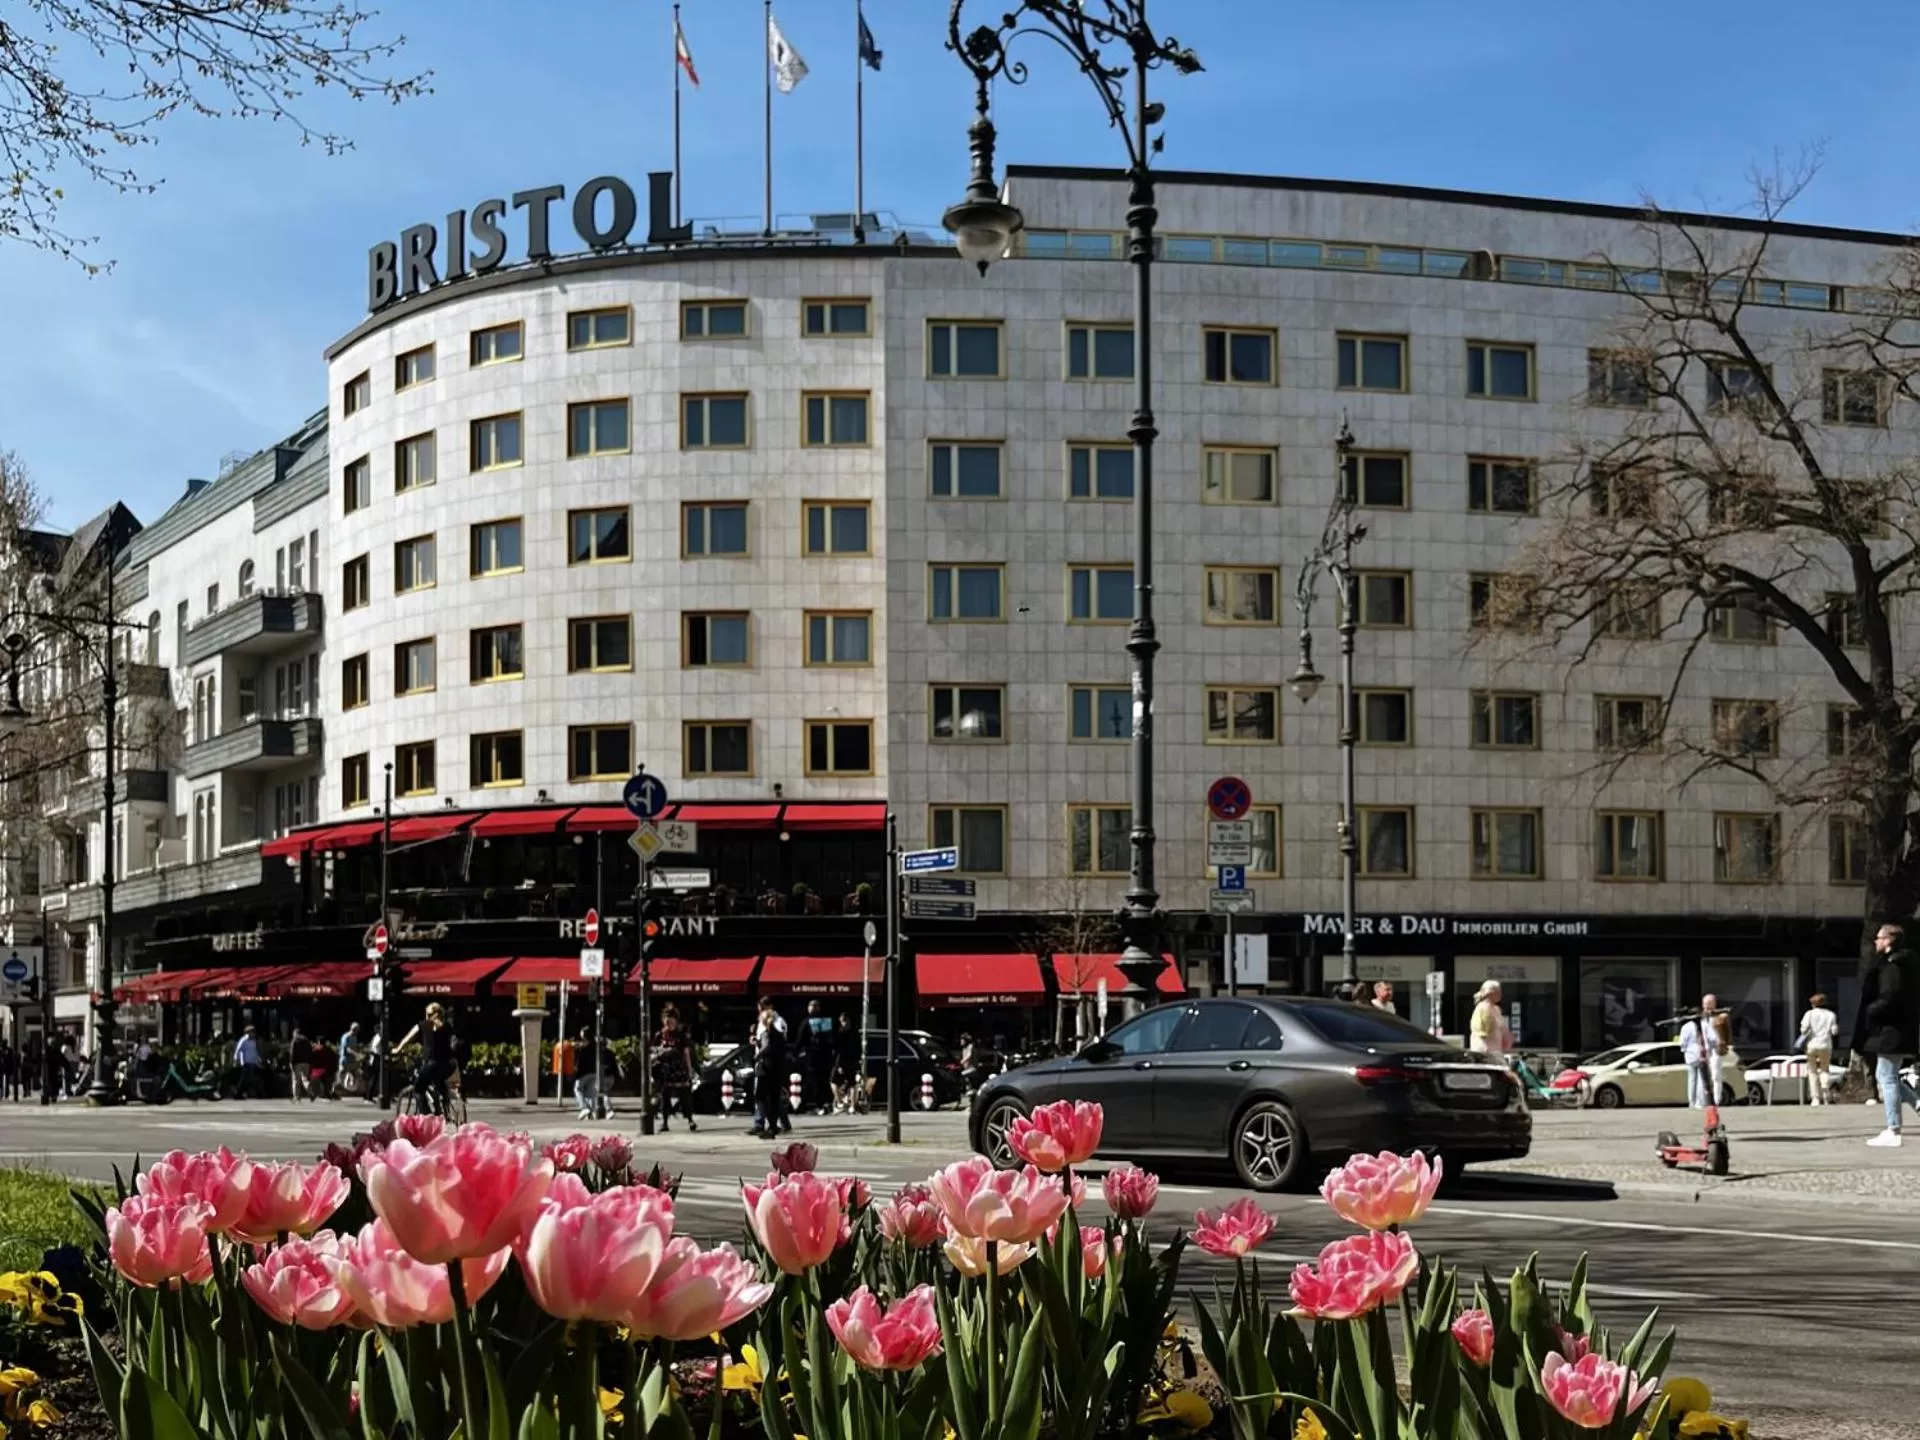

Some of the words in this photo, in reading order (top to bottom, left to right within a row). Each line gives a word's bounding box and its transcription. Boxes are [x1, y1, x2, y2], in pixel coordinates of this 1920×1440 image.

[369, 171, 694, 313] BRISTOL
[1378, 917, 1394, 934] &
[1400, 914, 1446, 935] DAU
[1452, 920, 1539, 935] IMMOBILIEN
[212, 931, 265, 952] KAFFEE
[652, 983, 693, 992] Restaurant
